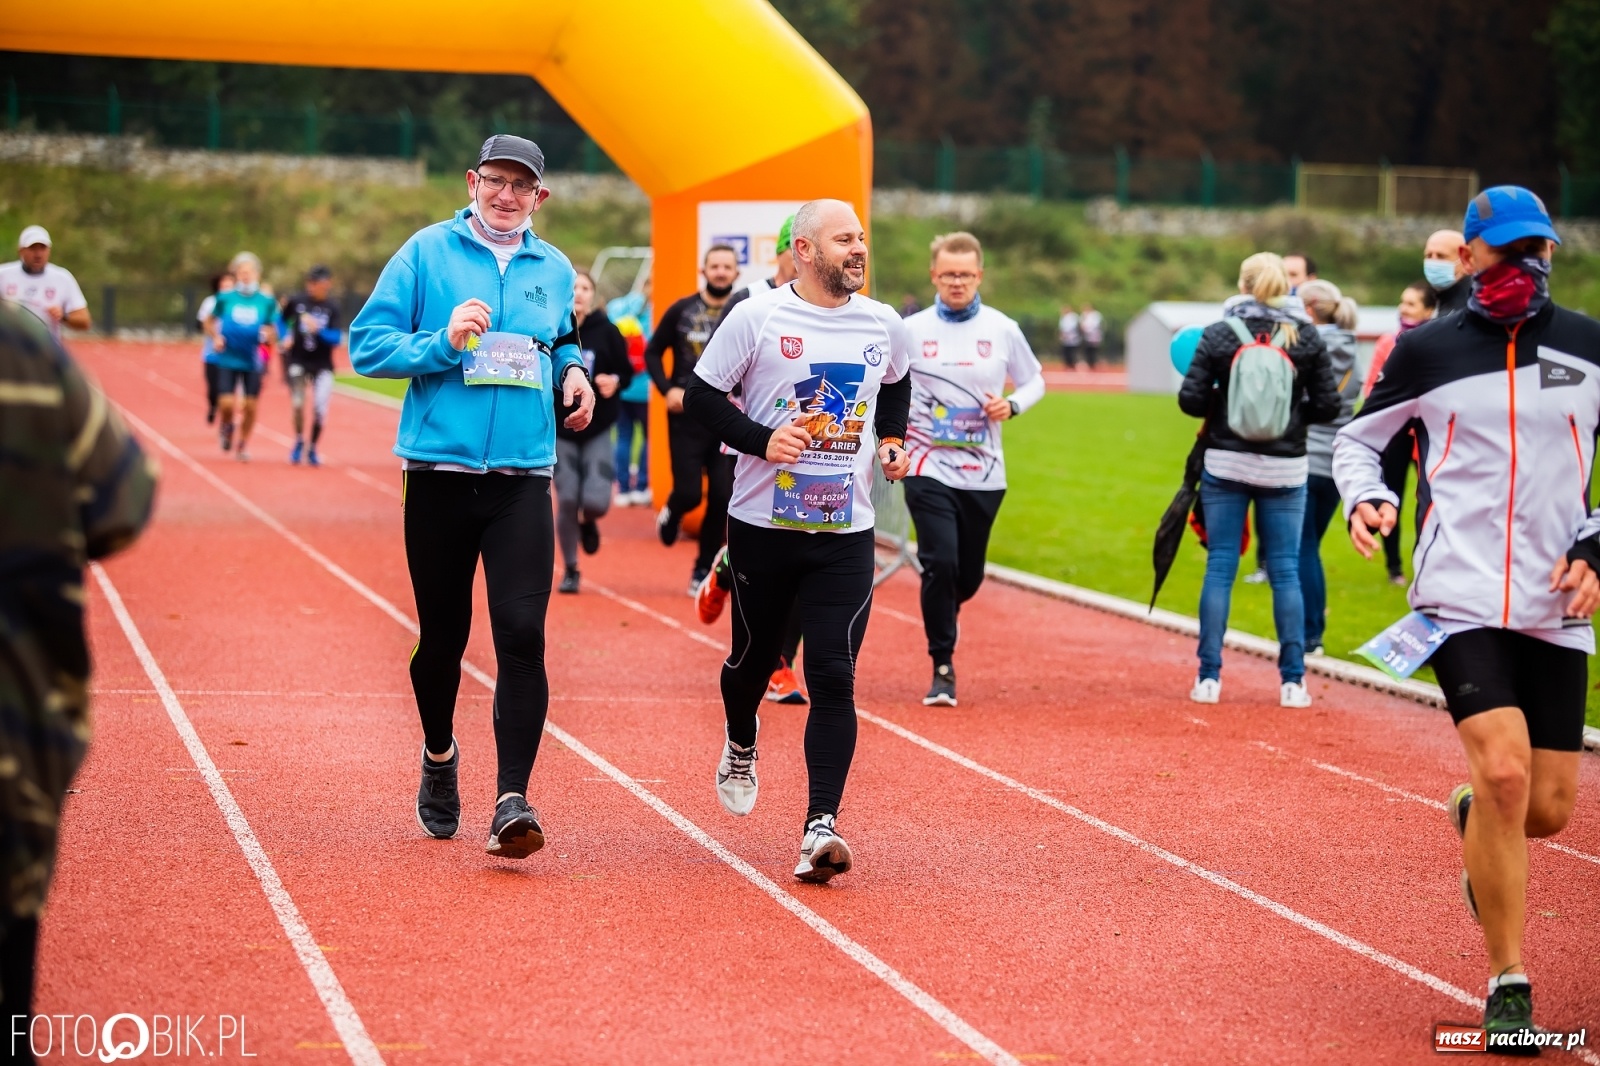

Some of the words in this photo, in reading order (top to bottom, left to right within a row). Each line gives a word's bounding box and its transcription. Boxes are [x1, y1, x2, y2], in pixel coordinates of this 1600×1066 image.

[472, 350, 488, 358] BIEG
[491, 351, 505, 359] DLA
[510, 369, 535, 381] 295
[810, 440, 822, 449] EZ
[823, 440, 857, 451] BARIER
[812, 452, 850, 462] 25.05.2019
[785, 491, 801, 500] BIEG
[822, 511, 845, 522] 303
